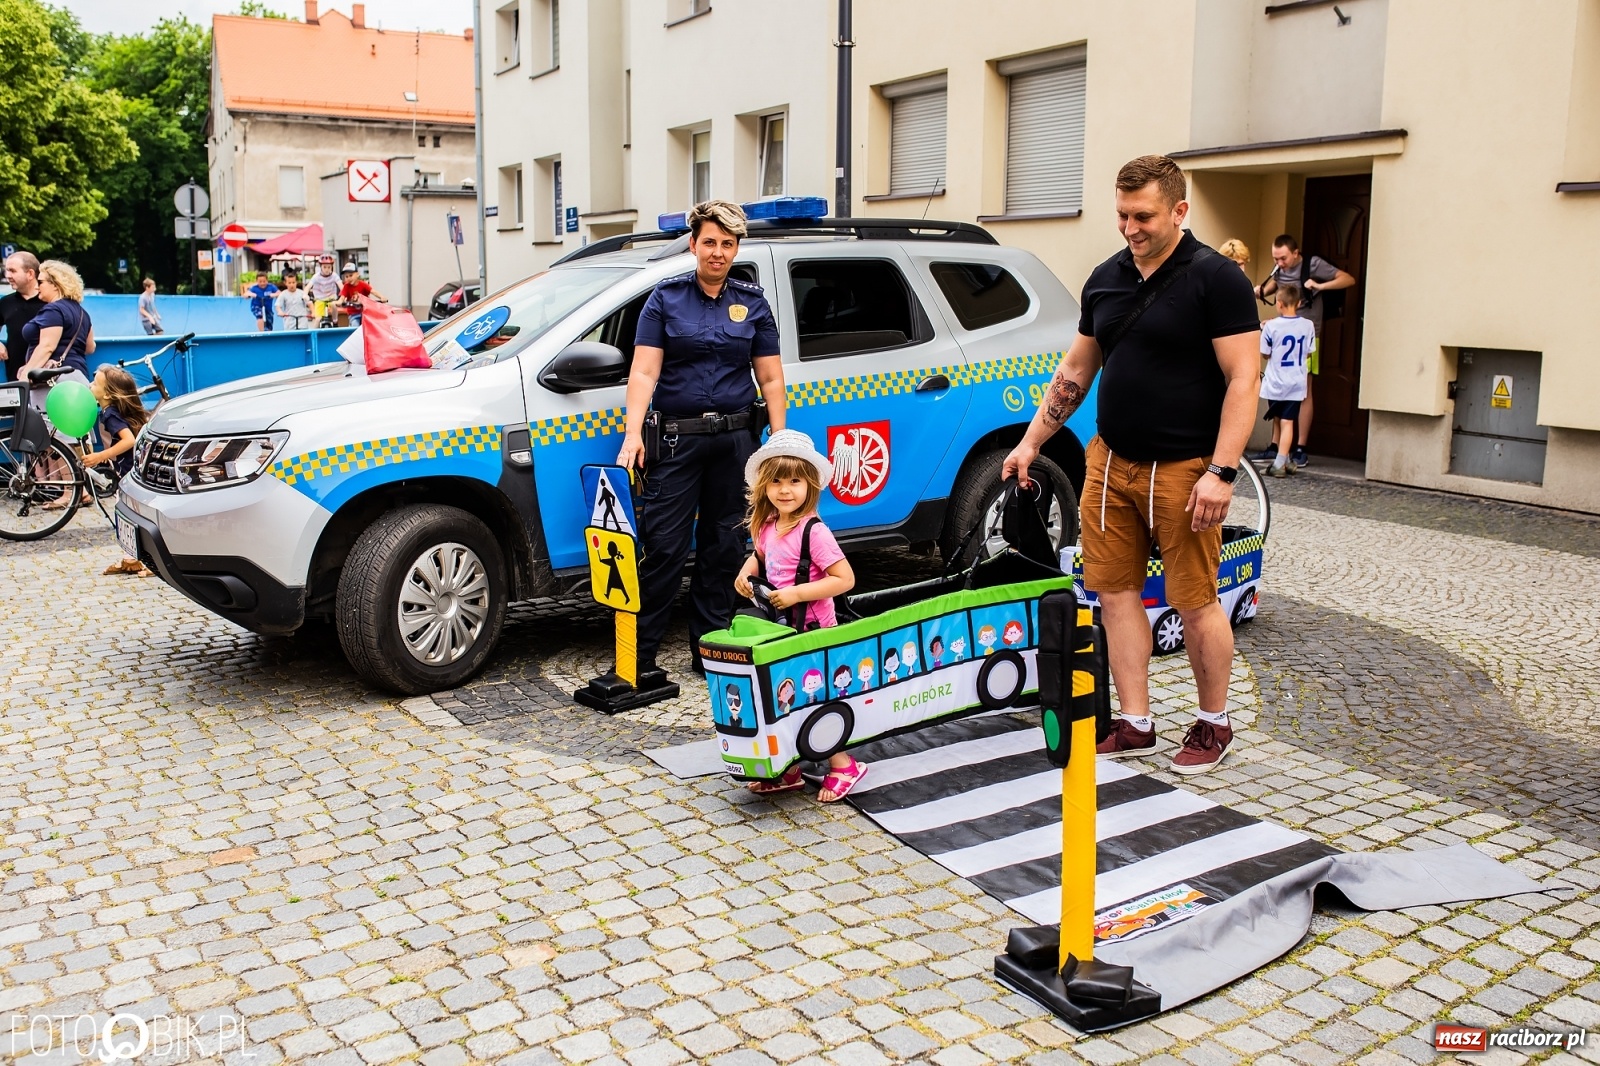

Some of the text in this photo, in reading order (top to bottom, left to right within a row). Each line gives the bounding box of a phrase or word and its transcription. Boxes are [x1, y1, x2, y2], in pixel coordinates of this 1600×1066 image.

[1281, 335, 1305, 367] 21
[712, 650, 722, 659] DO
[722, 651, 748, 662] DROGI
[893, 683, 953, 712] RACIBÓRZ
[1098, 888, 1185, 921] STOP ROBISZ KROK
